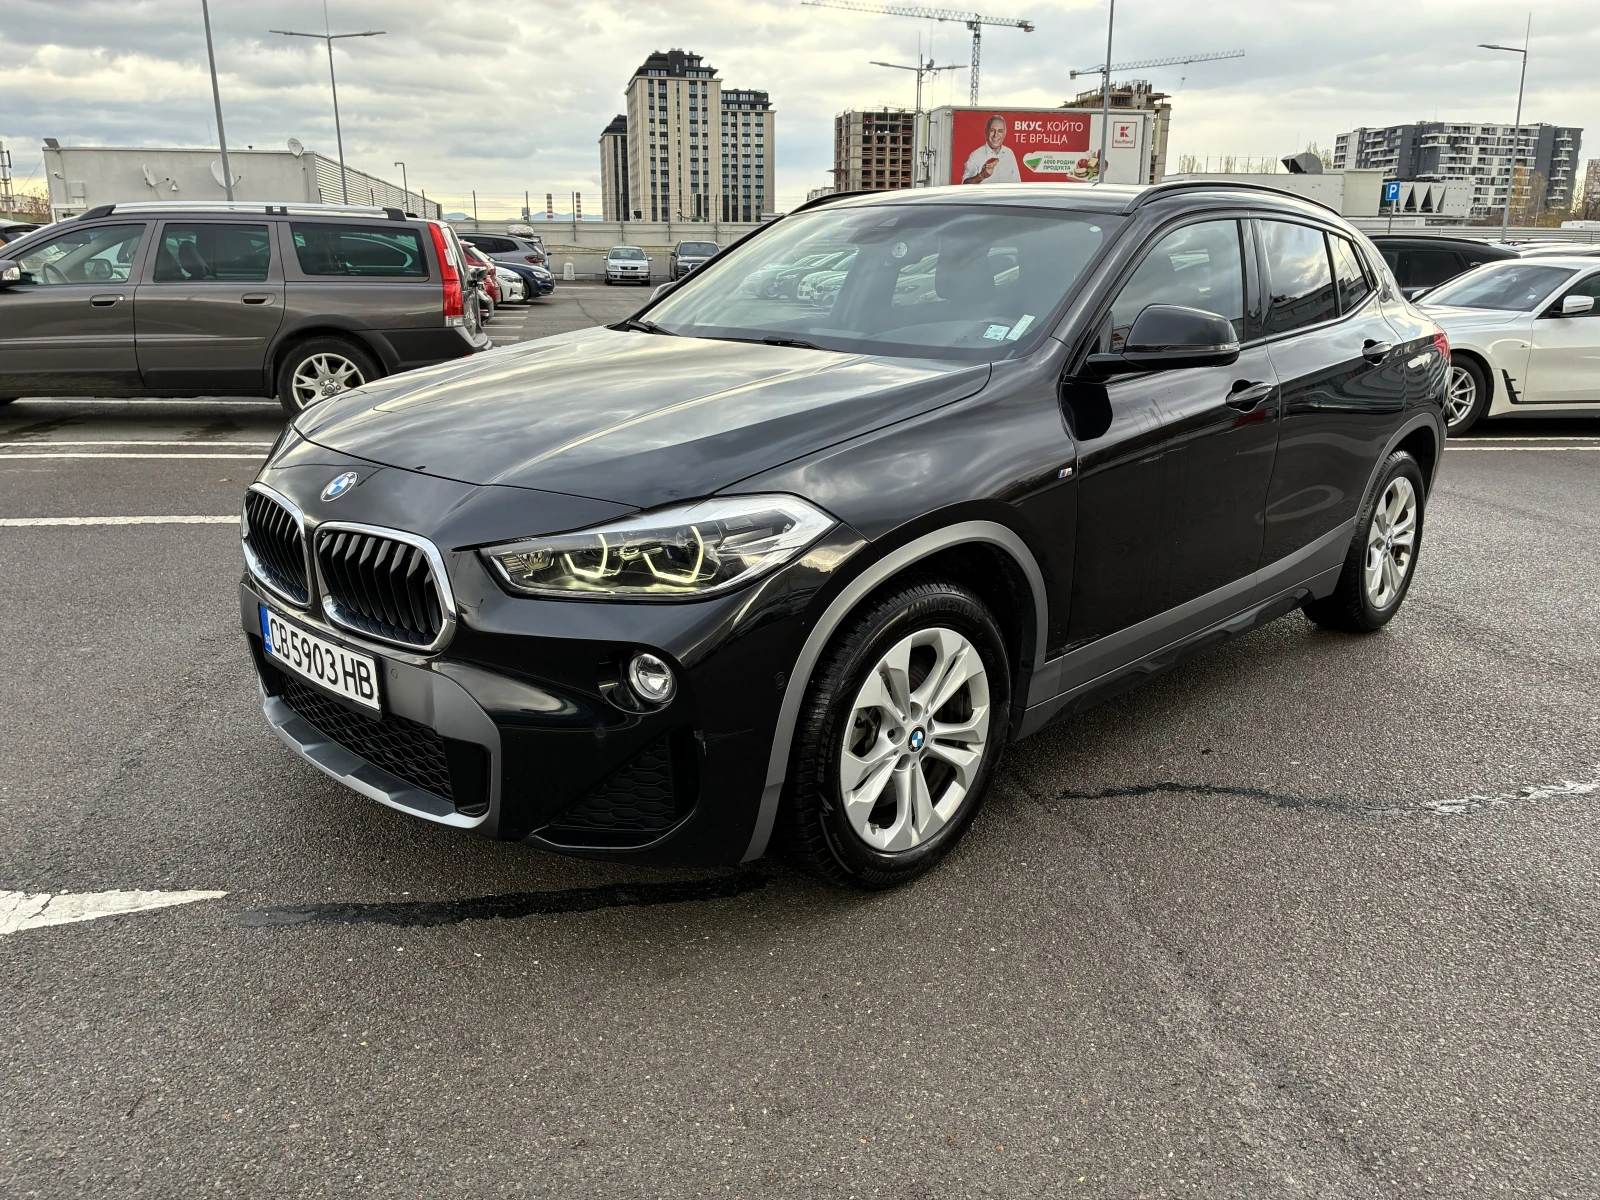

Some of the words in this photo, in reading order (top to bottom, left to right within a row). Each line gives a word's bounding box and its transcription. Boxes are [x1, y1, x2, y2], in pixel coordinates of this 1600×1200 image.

[1014, 121, 1044, 132] ВКУС,
[1047, 120, 1084, 132] КОЙТО
[1014, 133, 1027, 143] ТЕ
[1029, 133, 1068, 146] ВРЪЩА
[1388, 184, 1398, 198] P
